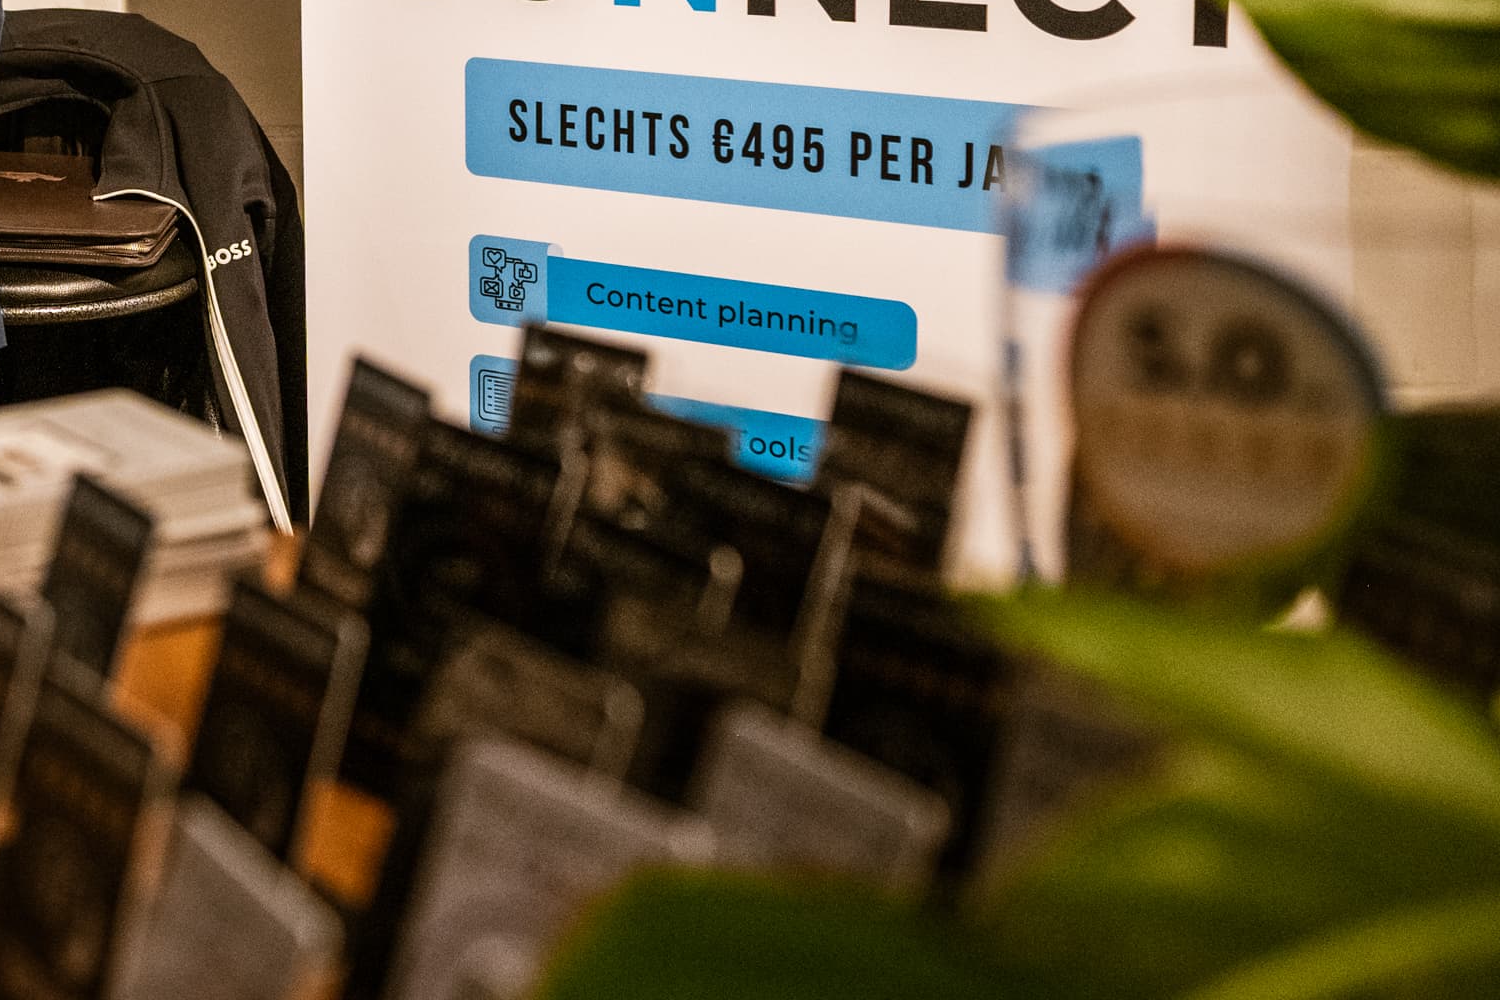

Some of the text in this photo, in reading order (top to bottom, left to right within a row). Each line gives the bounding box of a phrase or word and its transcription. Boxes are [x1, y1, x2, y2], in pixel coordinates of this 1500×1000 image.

[509, 99, 1007, 192] SLECHTS €495 PER JA
[207, 239, 252, 271] BOSS
[586, 282, 858, 345] Content planning
